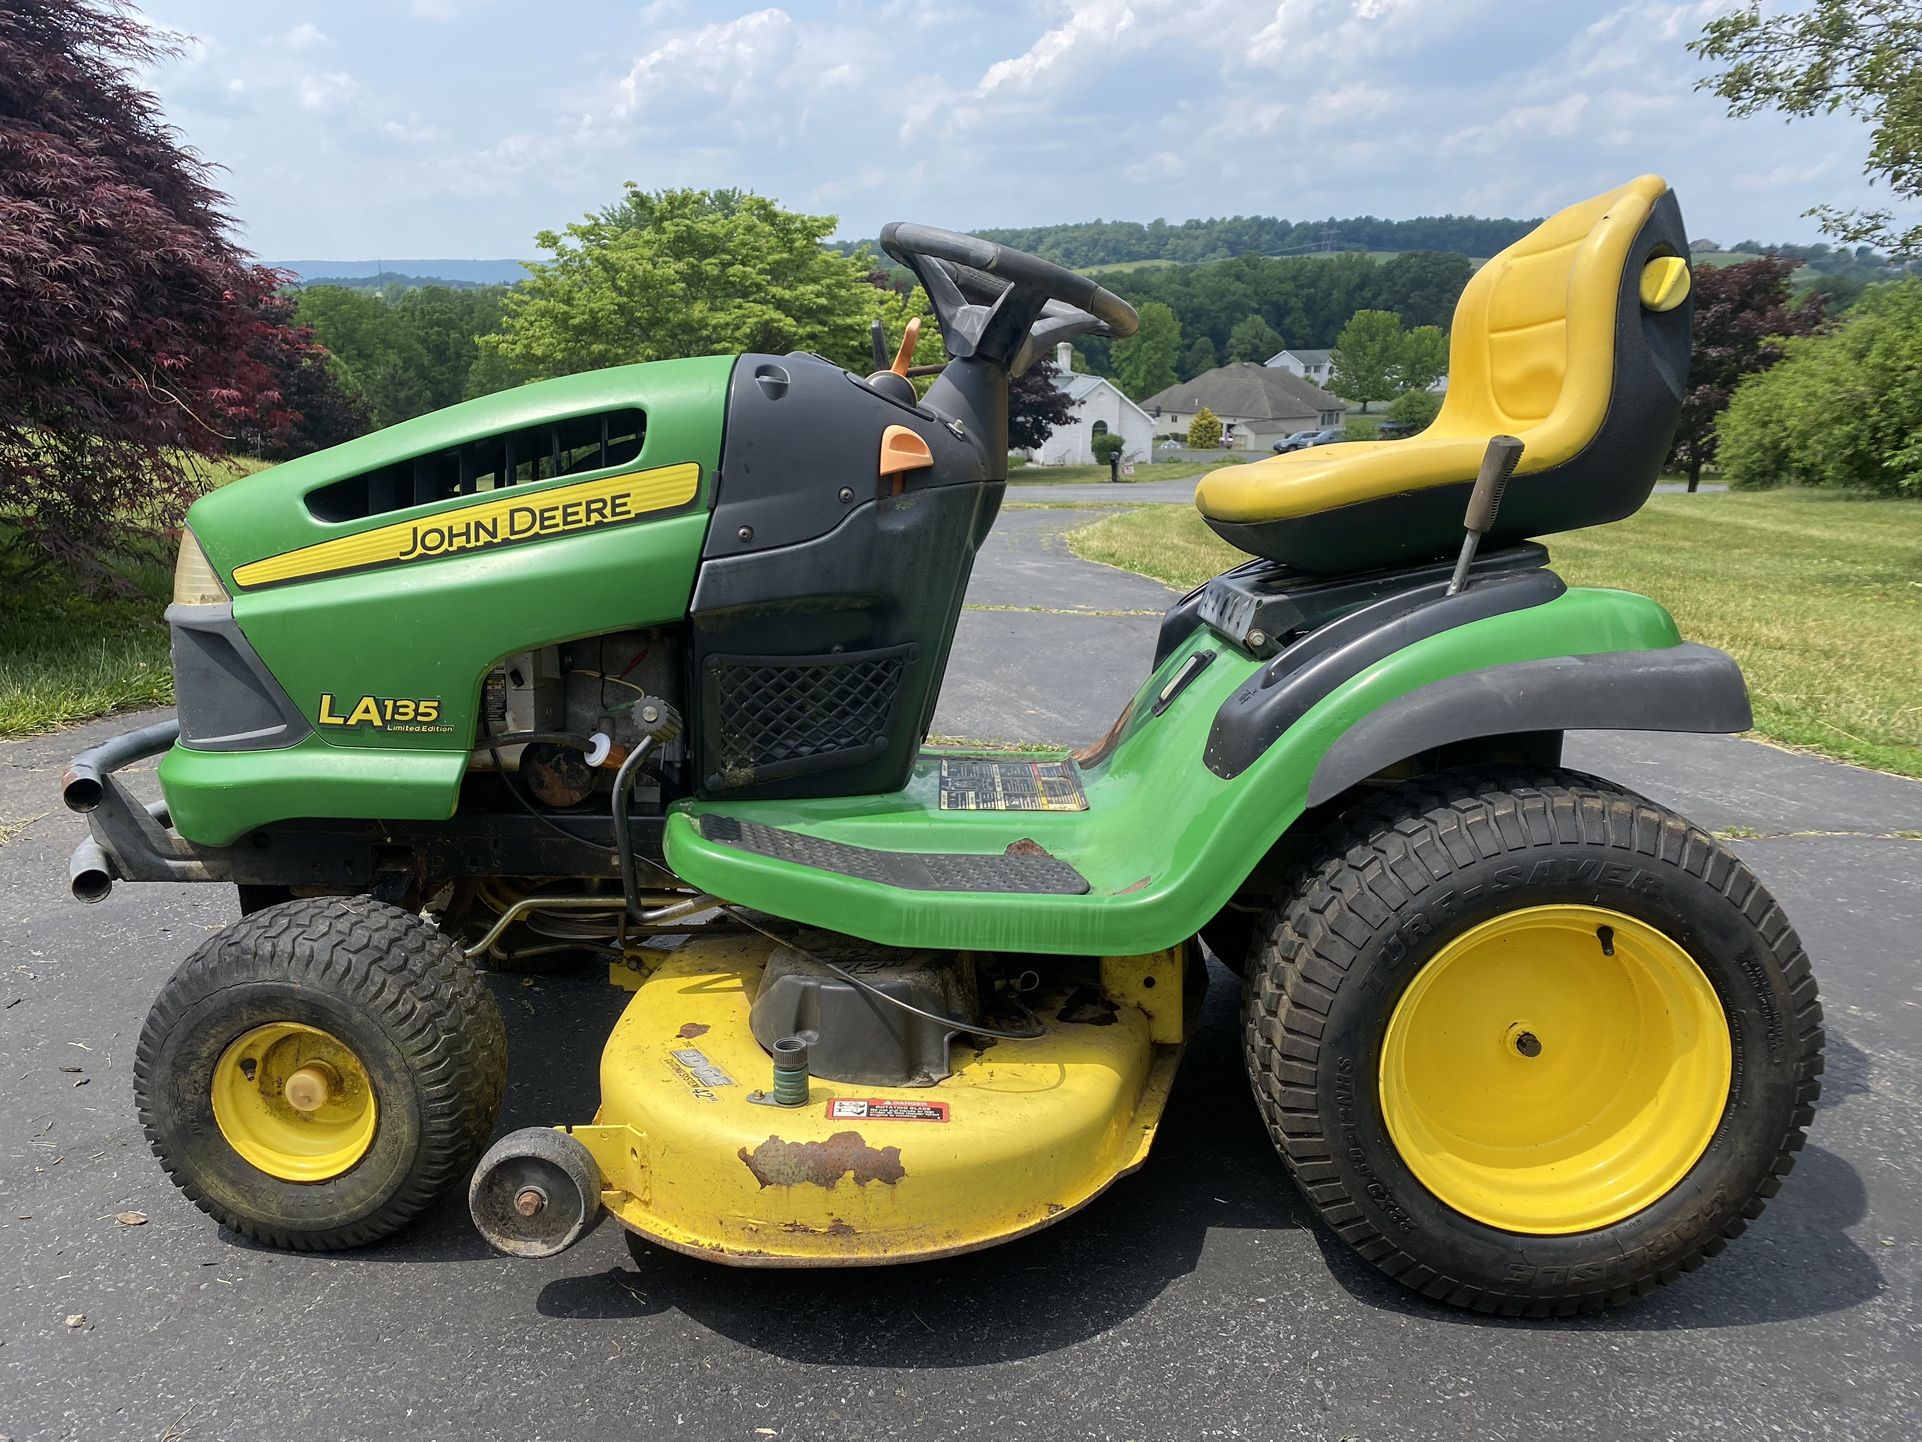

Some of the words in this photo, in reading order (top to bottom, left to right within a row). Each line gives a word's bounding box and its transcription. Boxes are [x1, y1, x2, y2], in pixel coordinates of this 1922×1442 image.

[399, 517, 498, 557] JOHN
[509, 492, 632, 537] DEERE
[318, 693, 440, 727] LA135
[386, 724, 420, 733] Limited
[421, 725, 453, 733] Edition
[670, 1048, 733, 1087] EDGE
